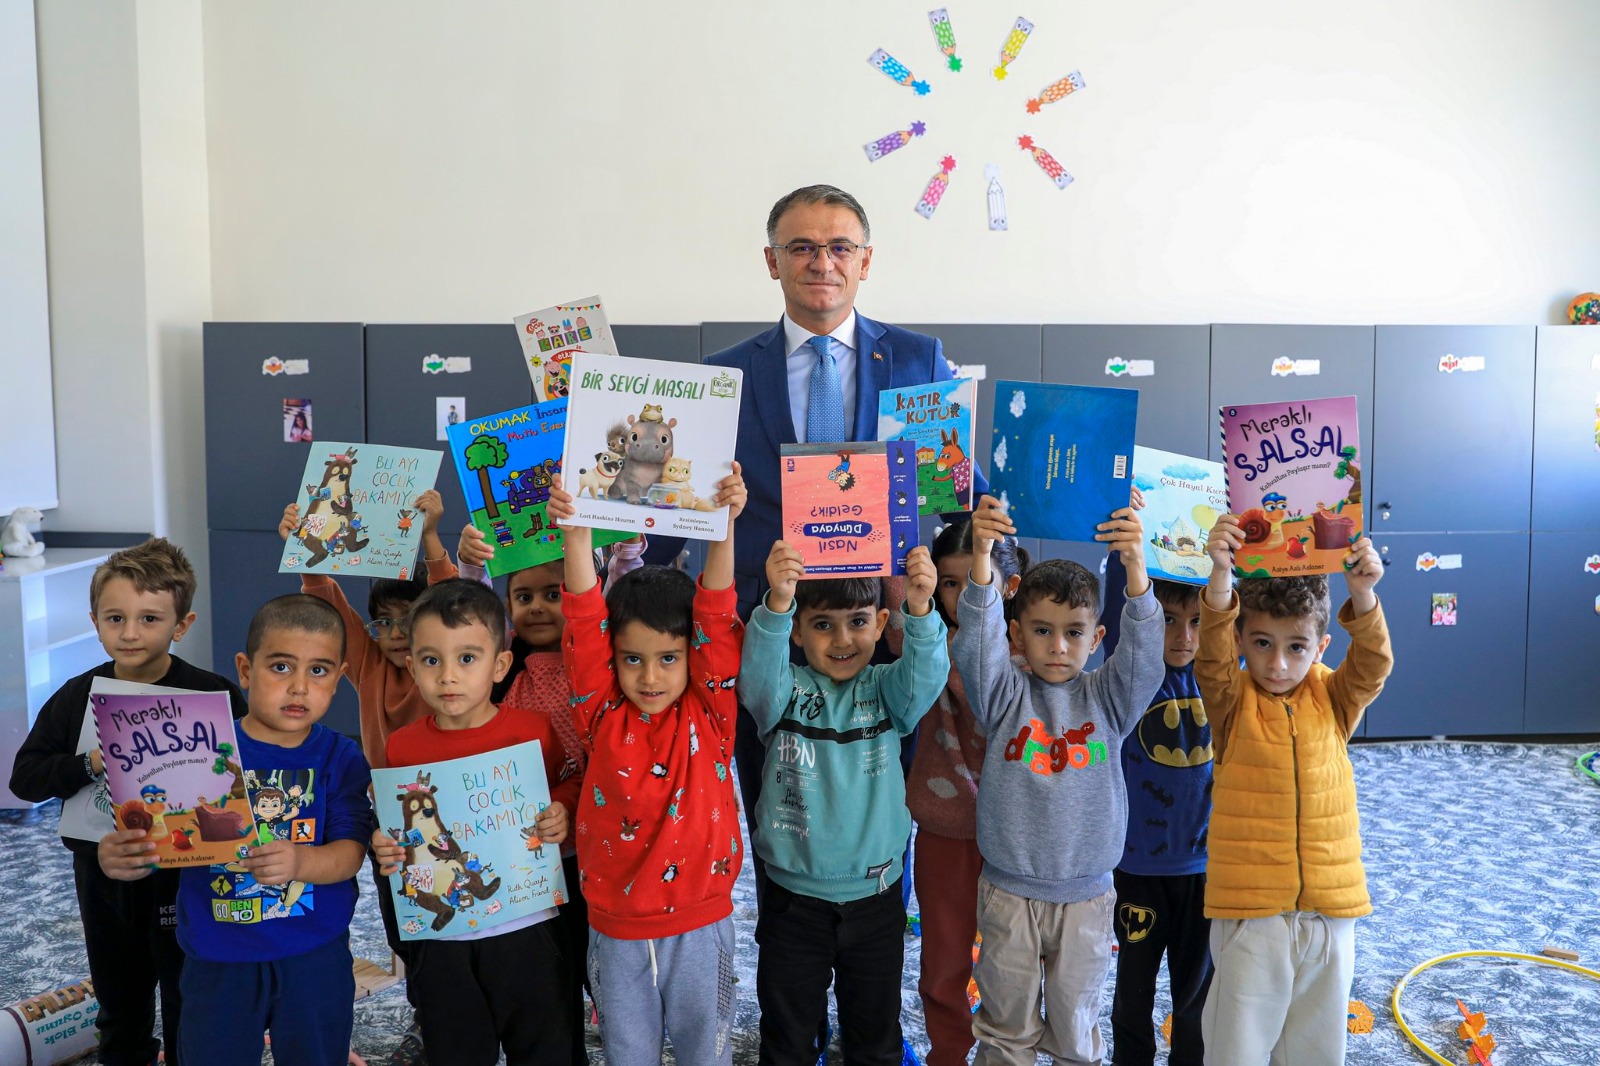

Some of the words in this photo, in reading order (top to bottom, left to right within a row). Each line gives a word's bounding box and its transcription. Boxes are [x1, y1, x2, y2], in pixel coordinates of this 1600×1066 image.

[538, 326, 592, 352] KARE
[557, 350, 574, 360] etki
[581, 369, 603, 390] BİR
[608, 374, 650, 395] SEVGİ
[652, 378, 705, 400] MASALI
[896, 392, 941, 413] KATIR
[470, 410, 531, 436] OKUMAK
[534, 405, 567, 420] İnsan
[1240, 404, 1311, 442] Meraklı
[507, 428, 538, 443] Mutlu
[1234, 425, 1352, 482] SALSAL
[376, 455, 394, 470] BU
[399, 457, 419, 472] AYI
[372, 472, 416, 488] ÇOCUK
[1160, 477, 1176, 486] Çok
[1179, 480, 1204, 491] Hayal
[1206, 485, 1227, 496] Kura
[353, 490, 417, 506] BAKAMIYO
[1208, 495, 1228, 505] Çocu
[810, 504, 863, 517] Geldik?
[811, 523, 863, 534] Dünyaya
[819, 540, 858, 553] Nasıl
[111, 697, 182, 732] Meraklı
[109, 721, 229, 773] SALSAL
[1004, 725, 1107, 776] dragon
[462, 772, 485, 791] BU
[493, 759, 518, 782] AYI
[468, 784, 525, 814] ÇOCUK
[452, 802, 546, 842] BAKAMIYOR
[507, 883, 523, 893] Ruth
[509, 895, 530, 905] Alison
[531, 886, 550, 898] Friend
[160, 905, 176, 915] KE
[215, 903, 228, 918] GO
[230, 900, 252, 912] BEN
[231, 909, 253, 922] 10
[160, 916, 178, 926] RIS
[36, 1011, 82, 1035] Oyunu
[45, 1027, 77, 1045] Blok
